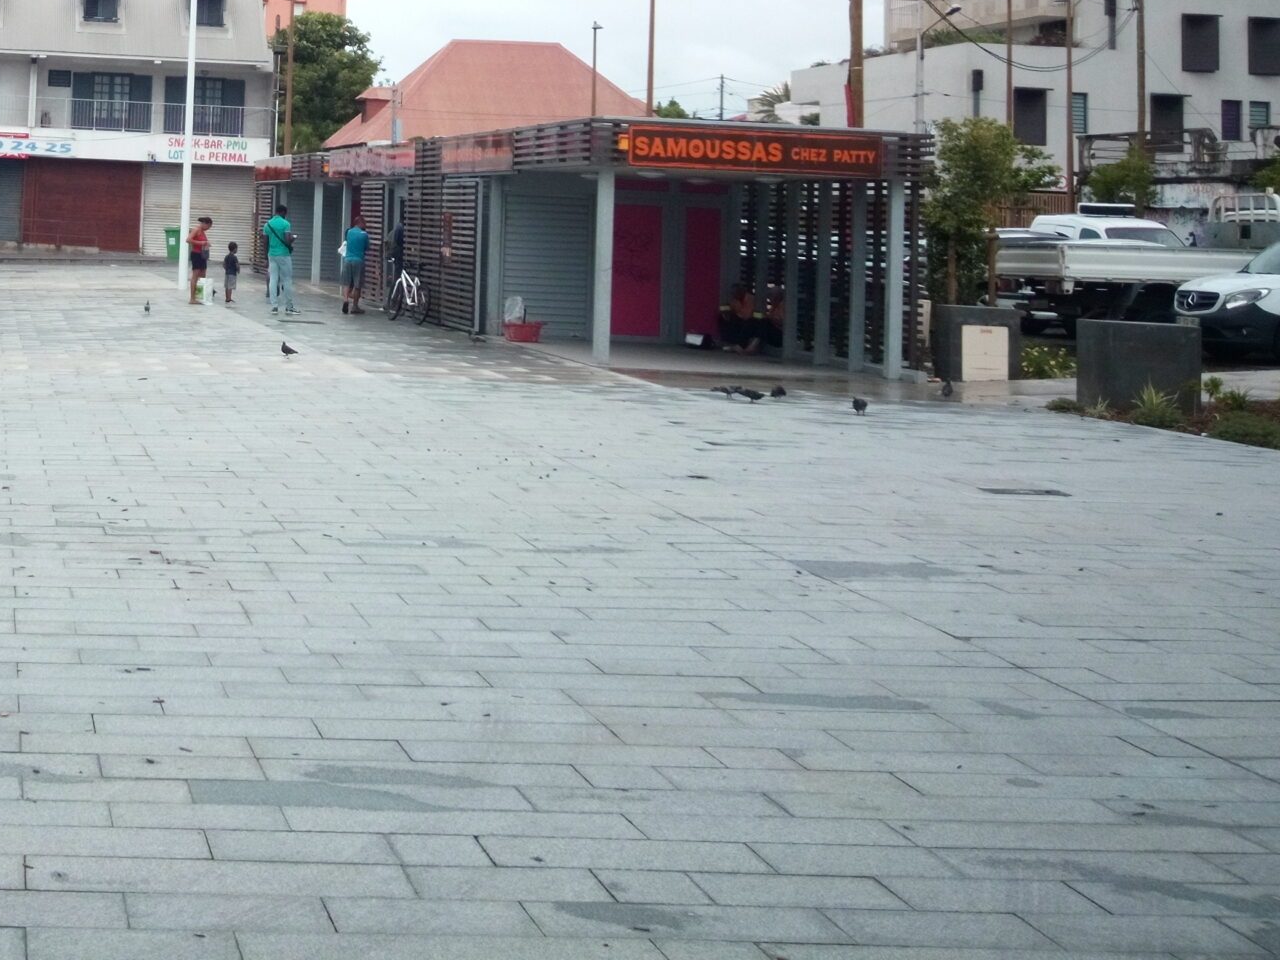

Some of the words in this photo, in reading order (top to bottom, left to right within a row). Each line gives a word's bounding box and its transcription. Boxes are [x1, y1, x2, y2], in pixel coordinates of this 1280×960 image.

[10, 140, 38, 152] 24
[44, 142, 73, 153] 25
[168, 137, 248, 151] SNAK-BAR-PMU
[634, 136, 783, 162] SAMOUSSAS
[791, 147, 827, 161] CHEZ
[833, 149, 876, 164] PATTY
[168, 149, 185, 160] LOT
[209, 151, 249, 163] PERMAL
